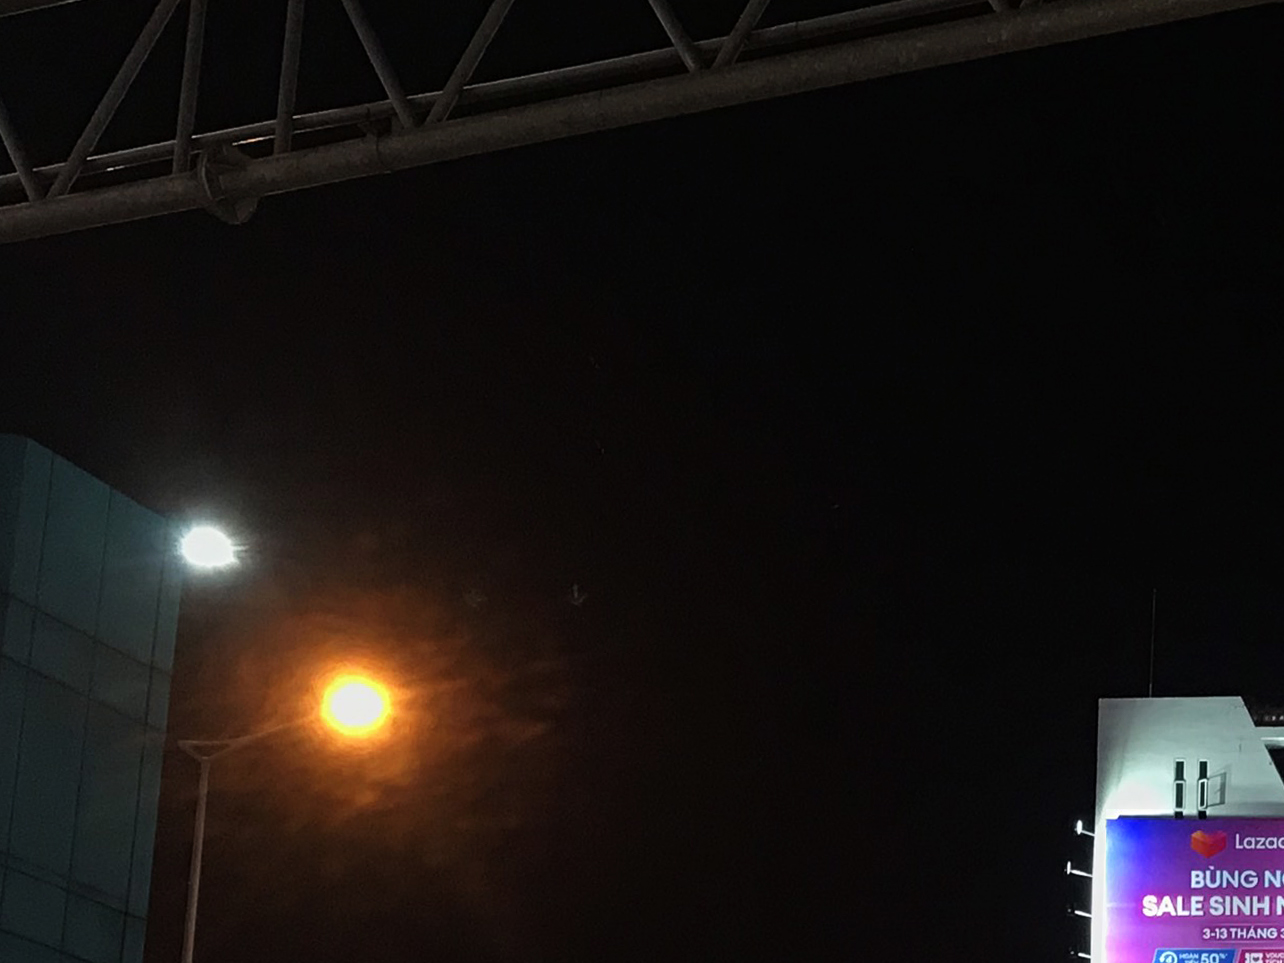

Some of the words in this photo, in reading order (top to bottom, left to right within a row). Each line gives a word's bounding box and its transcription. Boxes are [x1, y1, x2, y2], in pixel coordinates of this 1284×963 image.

[1190, 866, 1259, 889] BÙNG
[1142, 894, 1205, 917] SALE
[1209, 895, 1270, 916] SINH
[1202, 927, 1228, 940] 3-13
[1230, 925, 1278, 940] THÁNG
